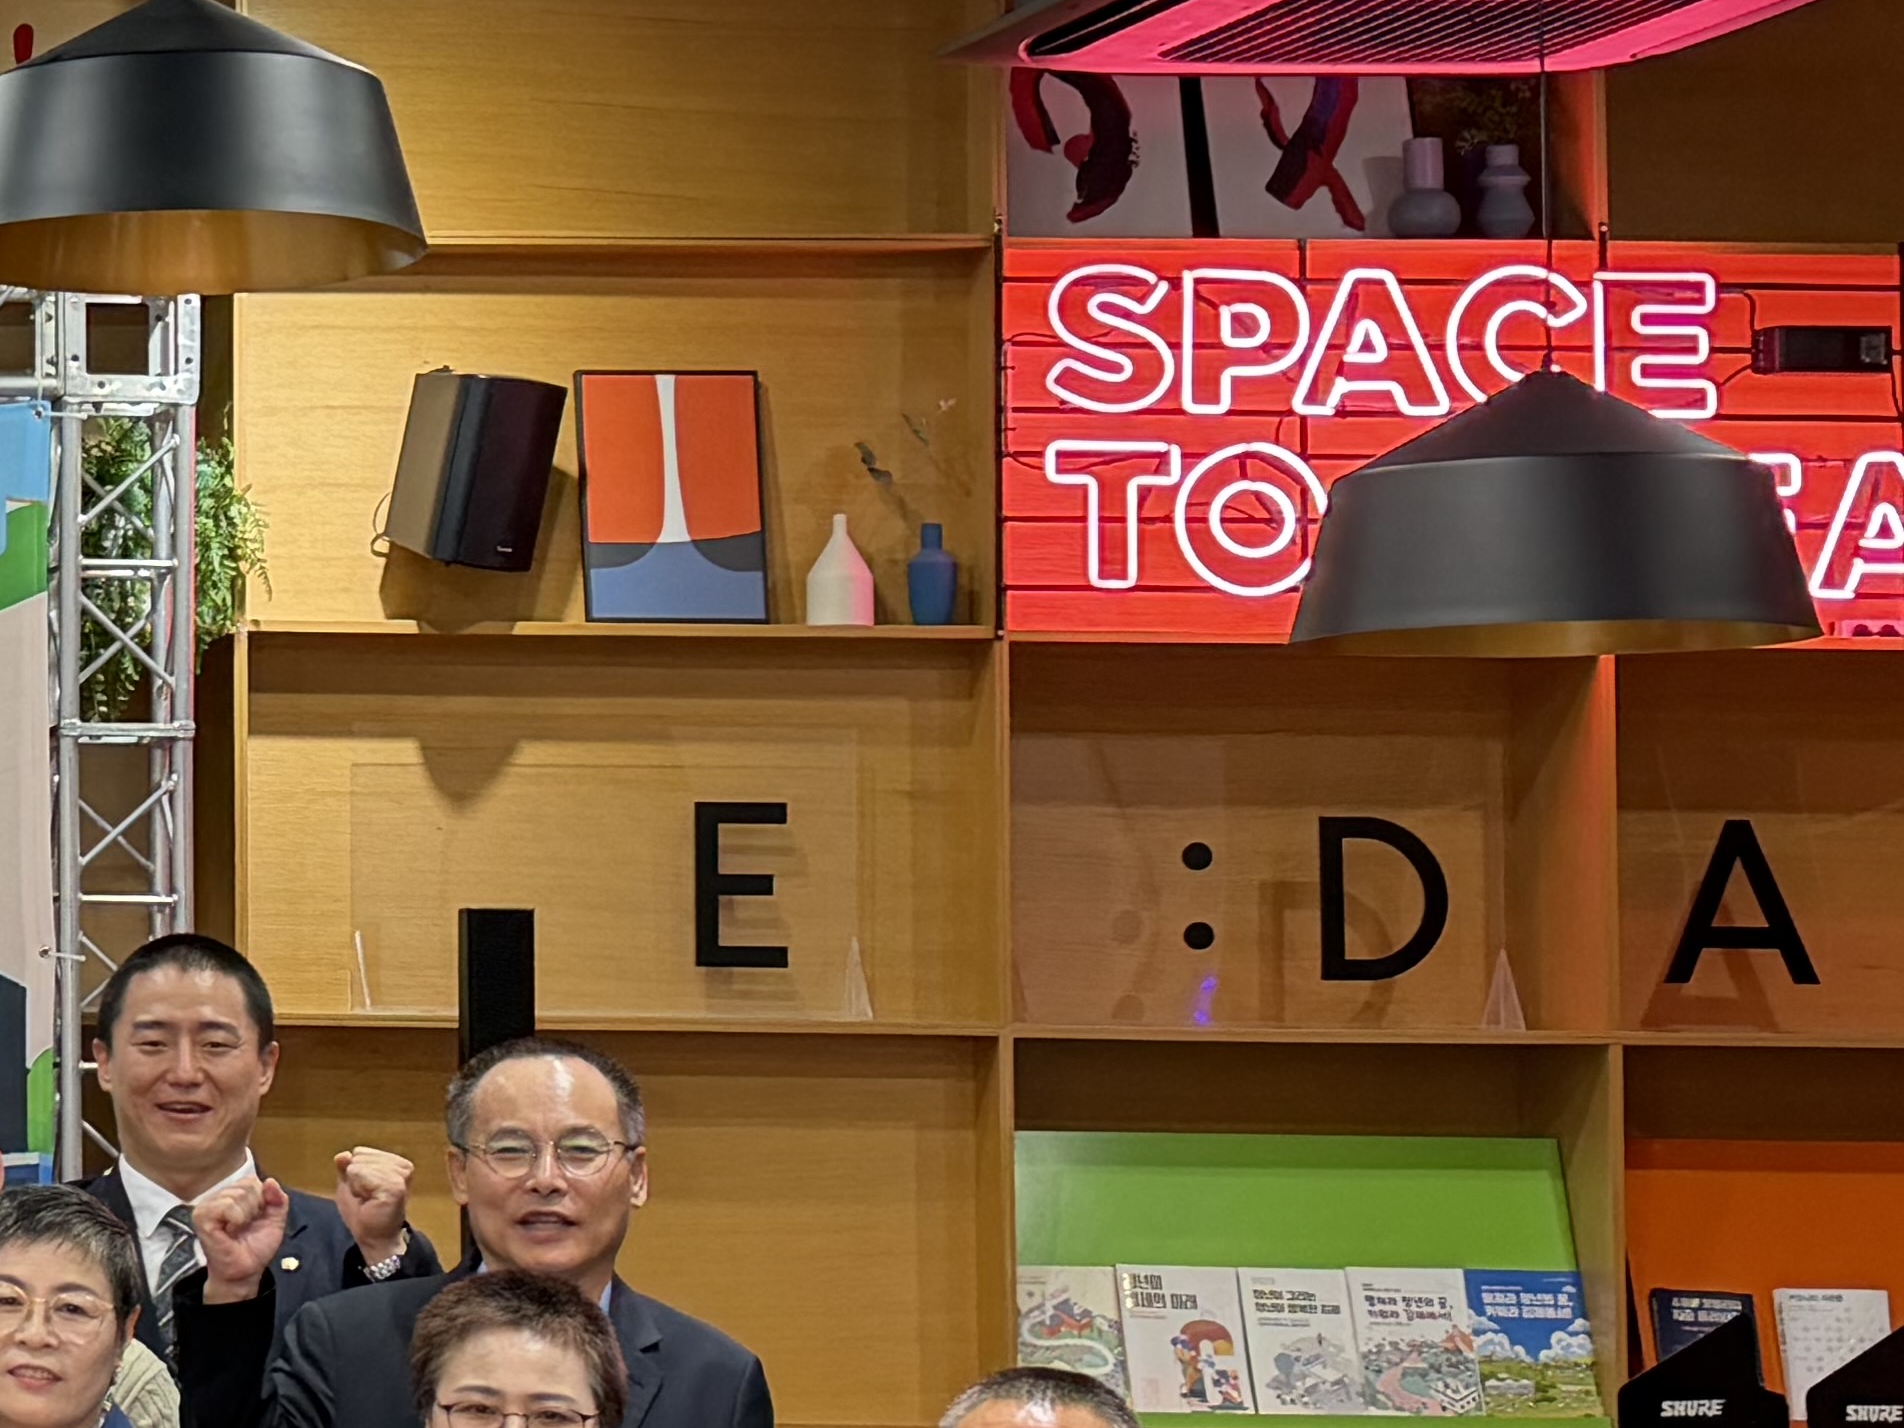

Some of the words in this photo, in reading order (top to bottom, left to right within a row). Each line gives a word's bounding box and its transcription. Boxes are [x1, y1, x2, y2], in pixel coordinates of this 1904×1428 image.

[1046, 263, 1718, 418] SPACE
[1660, 1399, 1726, 1418] SHURE
[1845, 1404, 1904, 1423] SHURE
